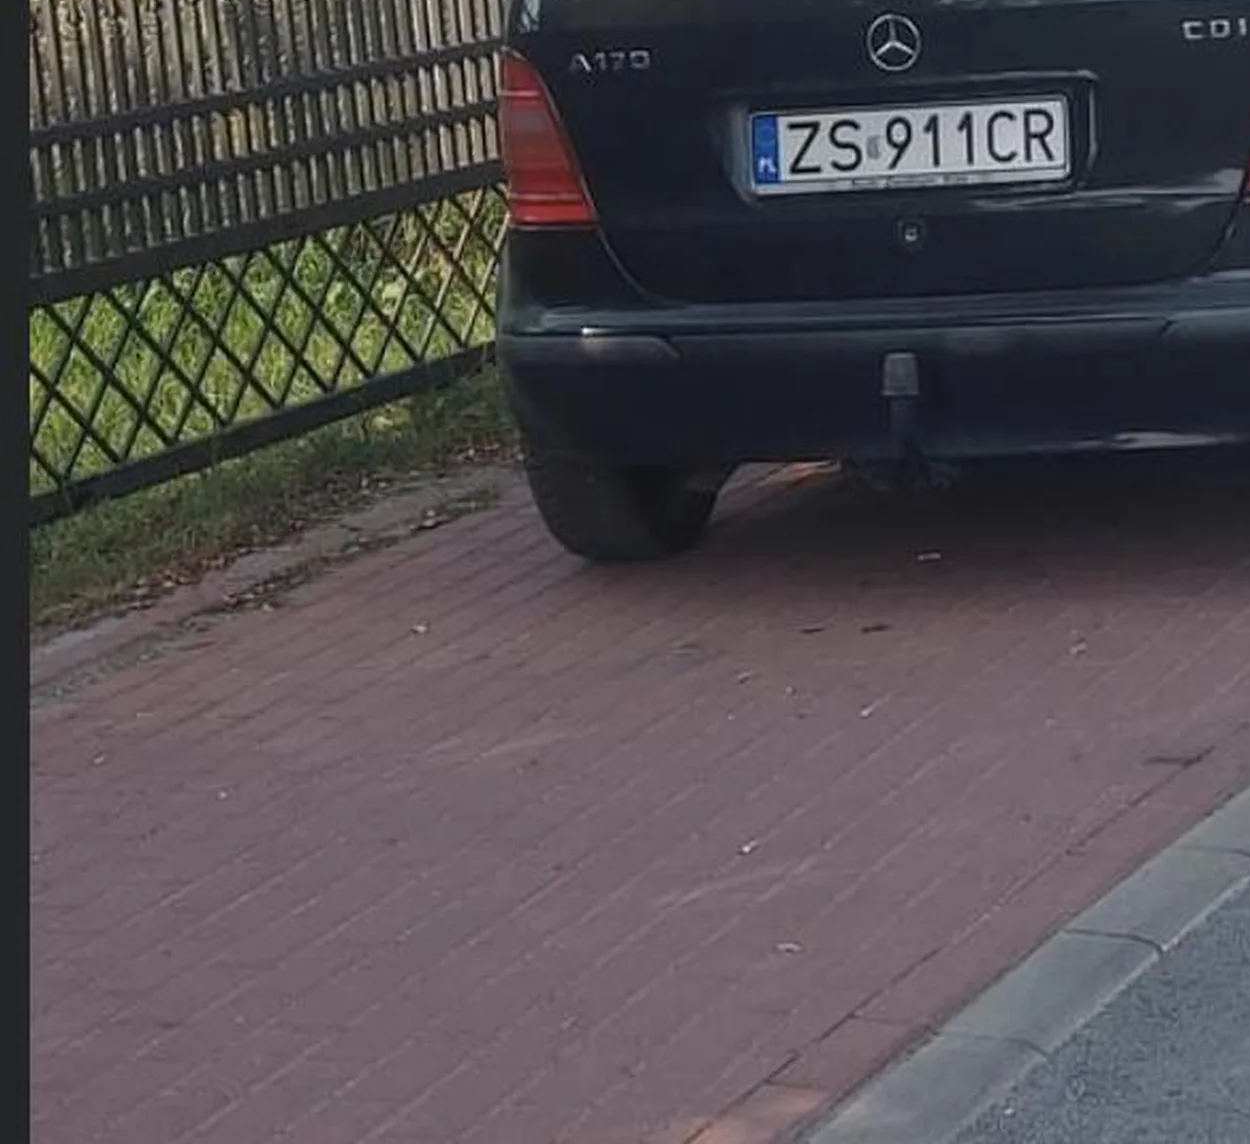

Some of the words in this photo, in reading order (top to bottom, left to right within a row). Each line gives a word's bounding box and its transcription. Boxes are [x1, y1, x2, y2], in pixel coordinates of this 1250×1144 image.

[1182, 18, 1248, 40] CDI
[570, 50, 651, 72] A170
[786, 119, 864, 175] ZS
[884, 108, 1056, 171] 911CR
